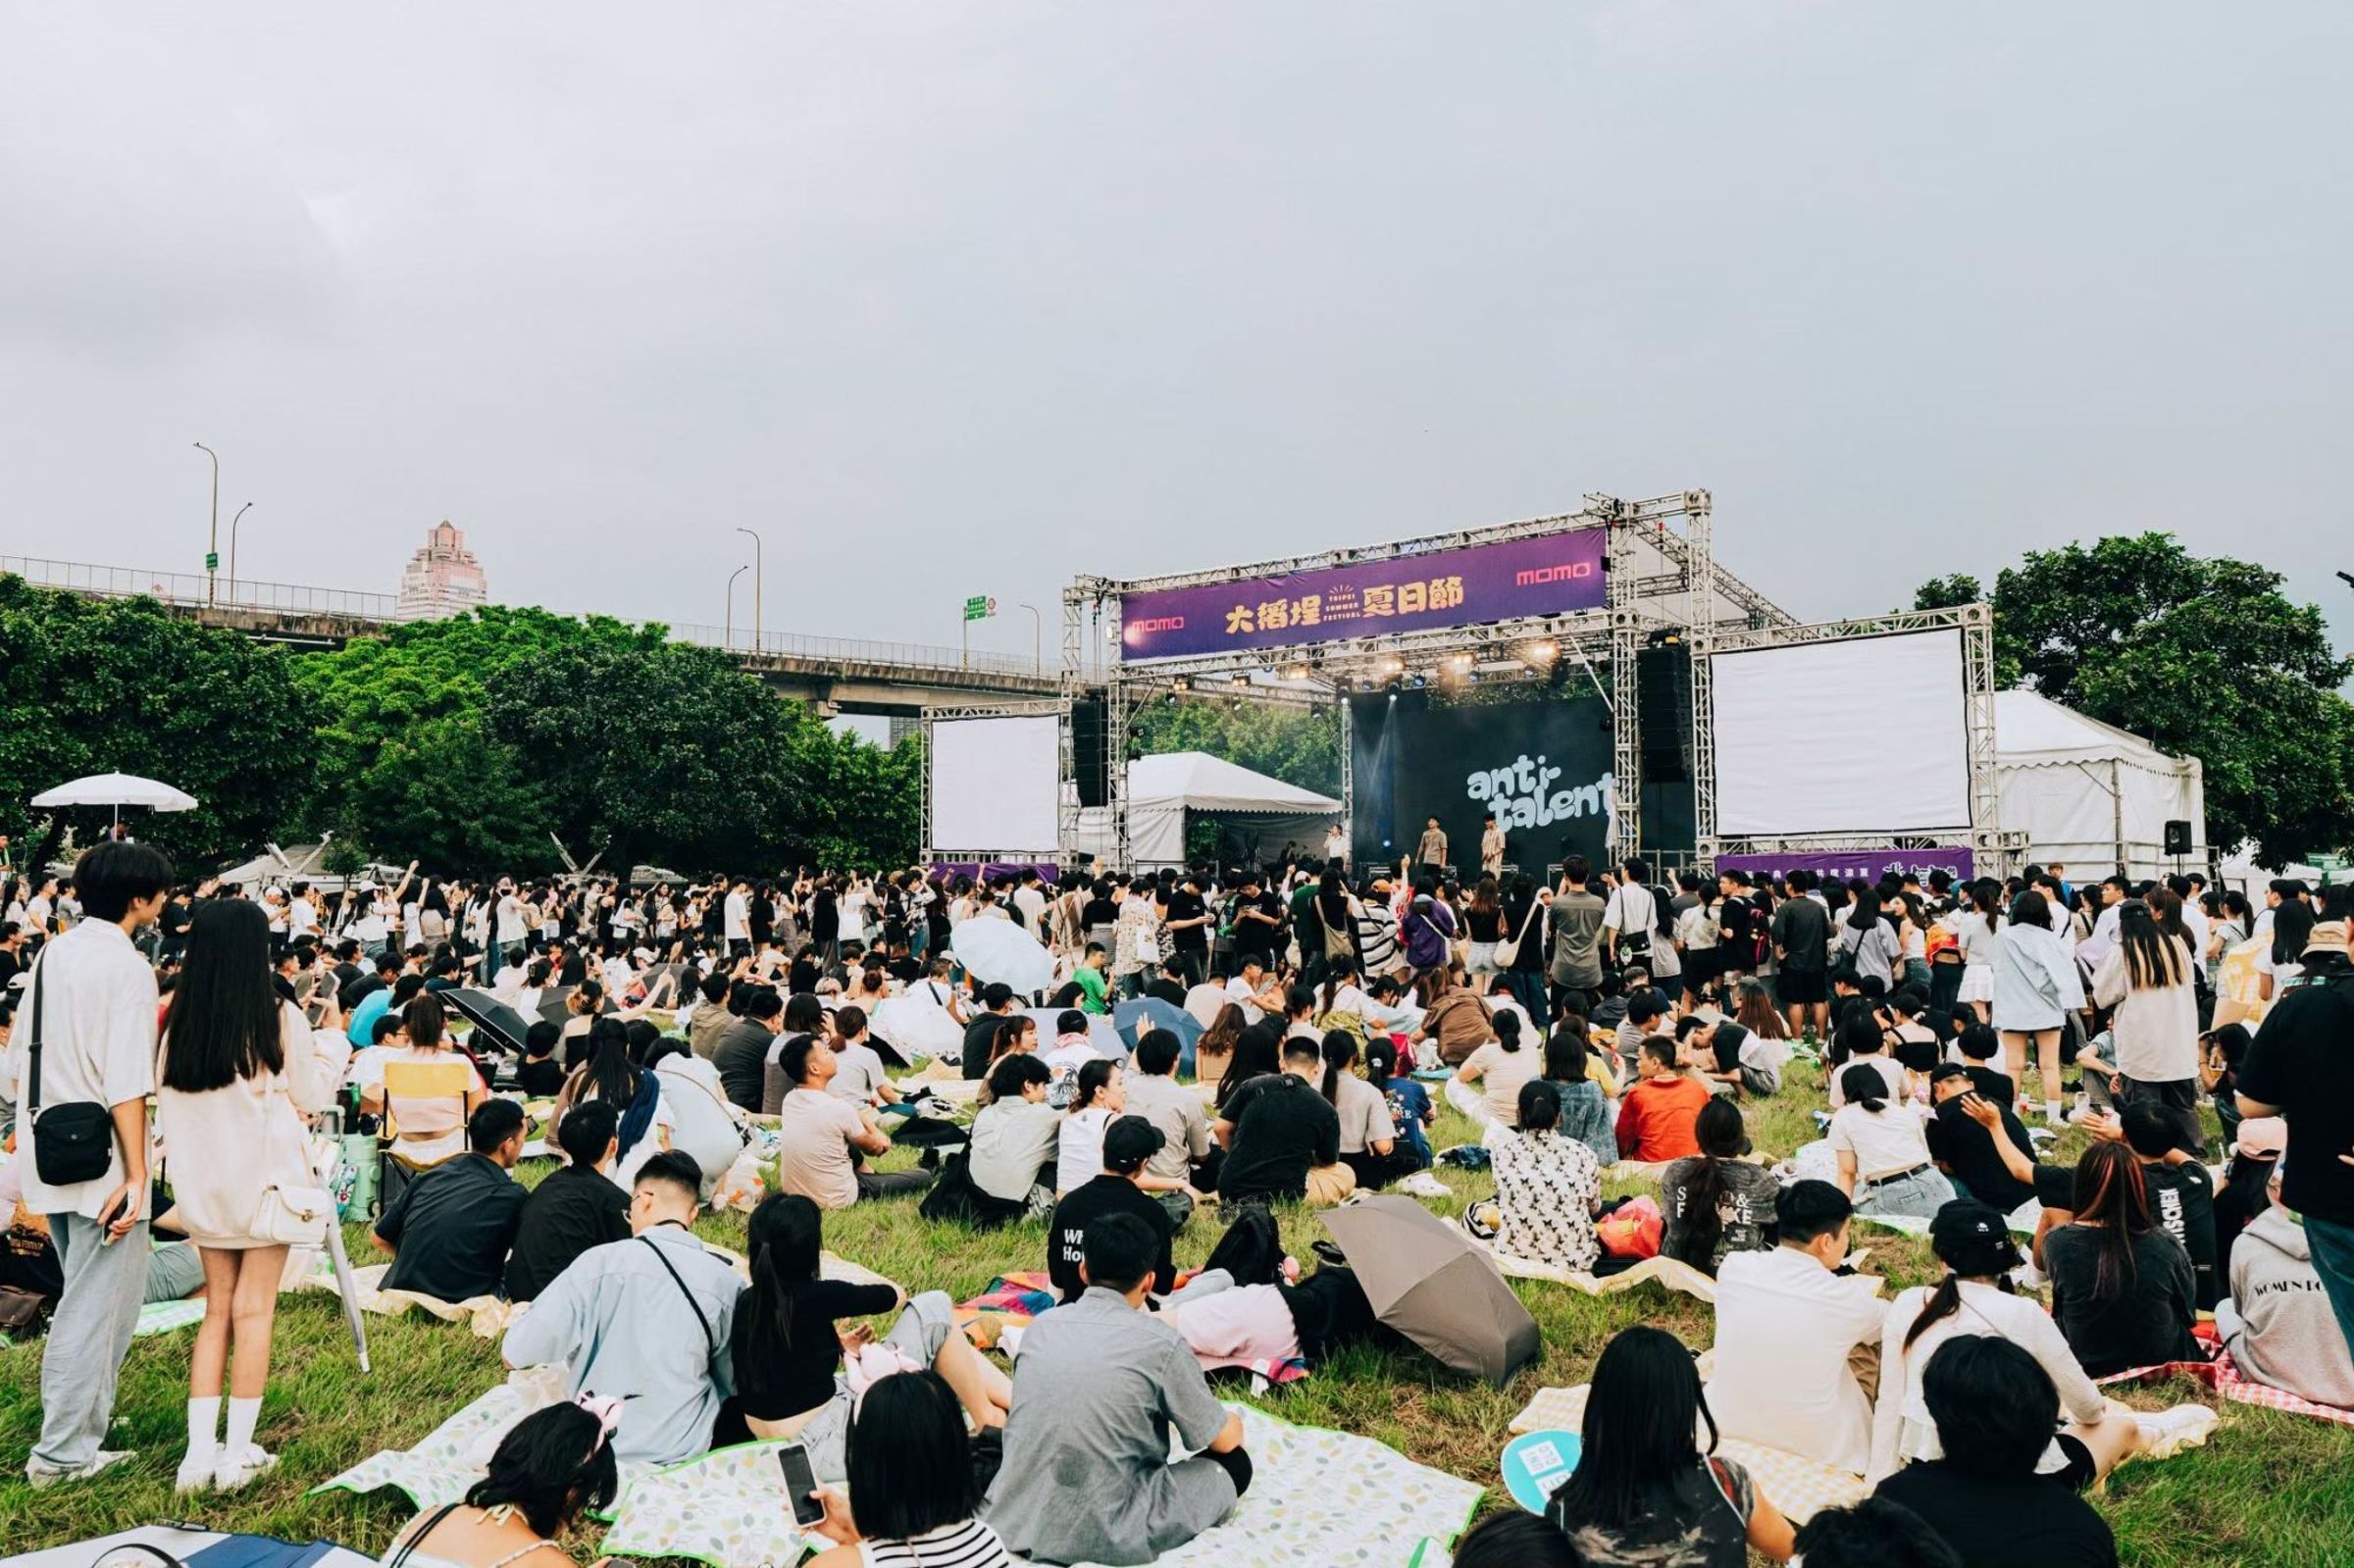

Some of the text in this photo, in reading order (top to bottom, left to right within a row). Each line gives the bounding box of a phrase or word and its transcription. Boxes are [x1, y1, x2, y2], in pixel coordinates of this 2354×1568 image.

[1516, 562, 1591, 586] momo
[1225, 576, 1464, 634] 大稻埕 夏日節
[1329, 593, 1356, 602] TAIPEI
[1326, 602, 1359, 612] SUMMER
[1323, 611, 1361, 622] FESTIVAL
[1467, 754, 1561, 801] anti-
[1488, 772, 1619, 834] talent
[1062, 1245, 1085, 1262] Ho
[2255, 1280, 2303, 1296] WOMEN
